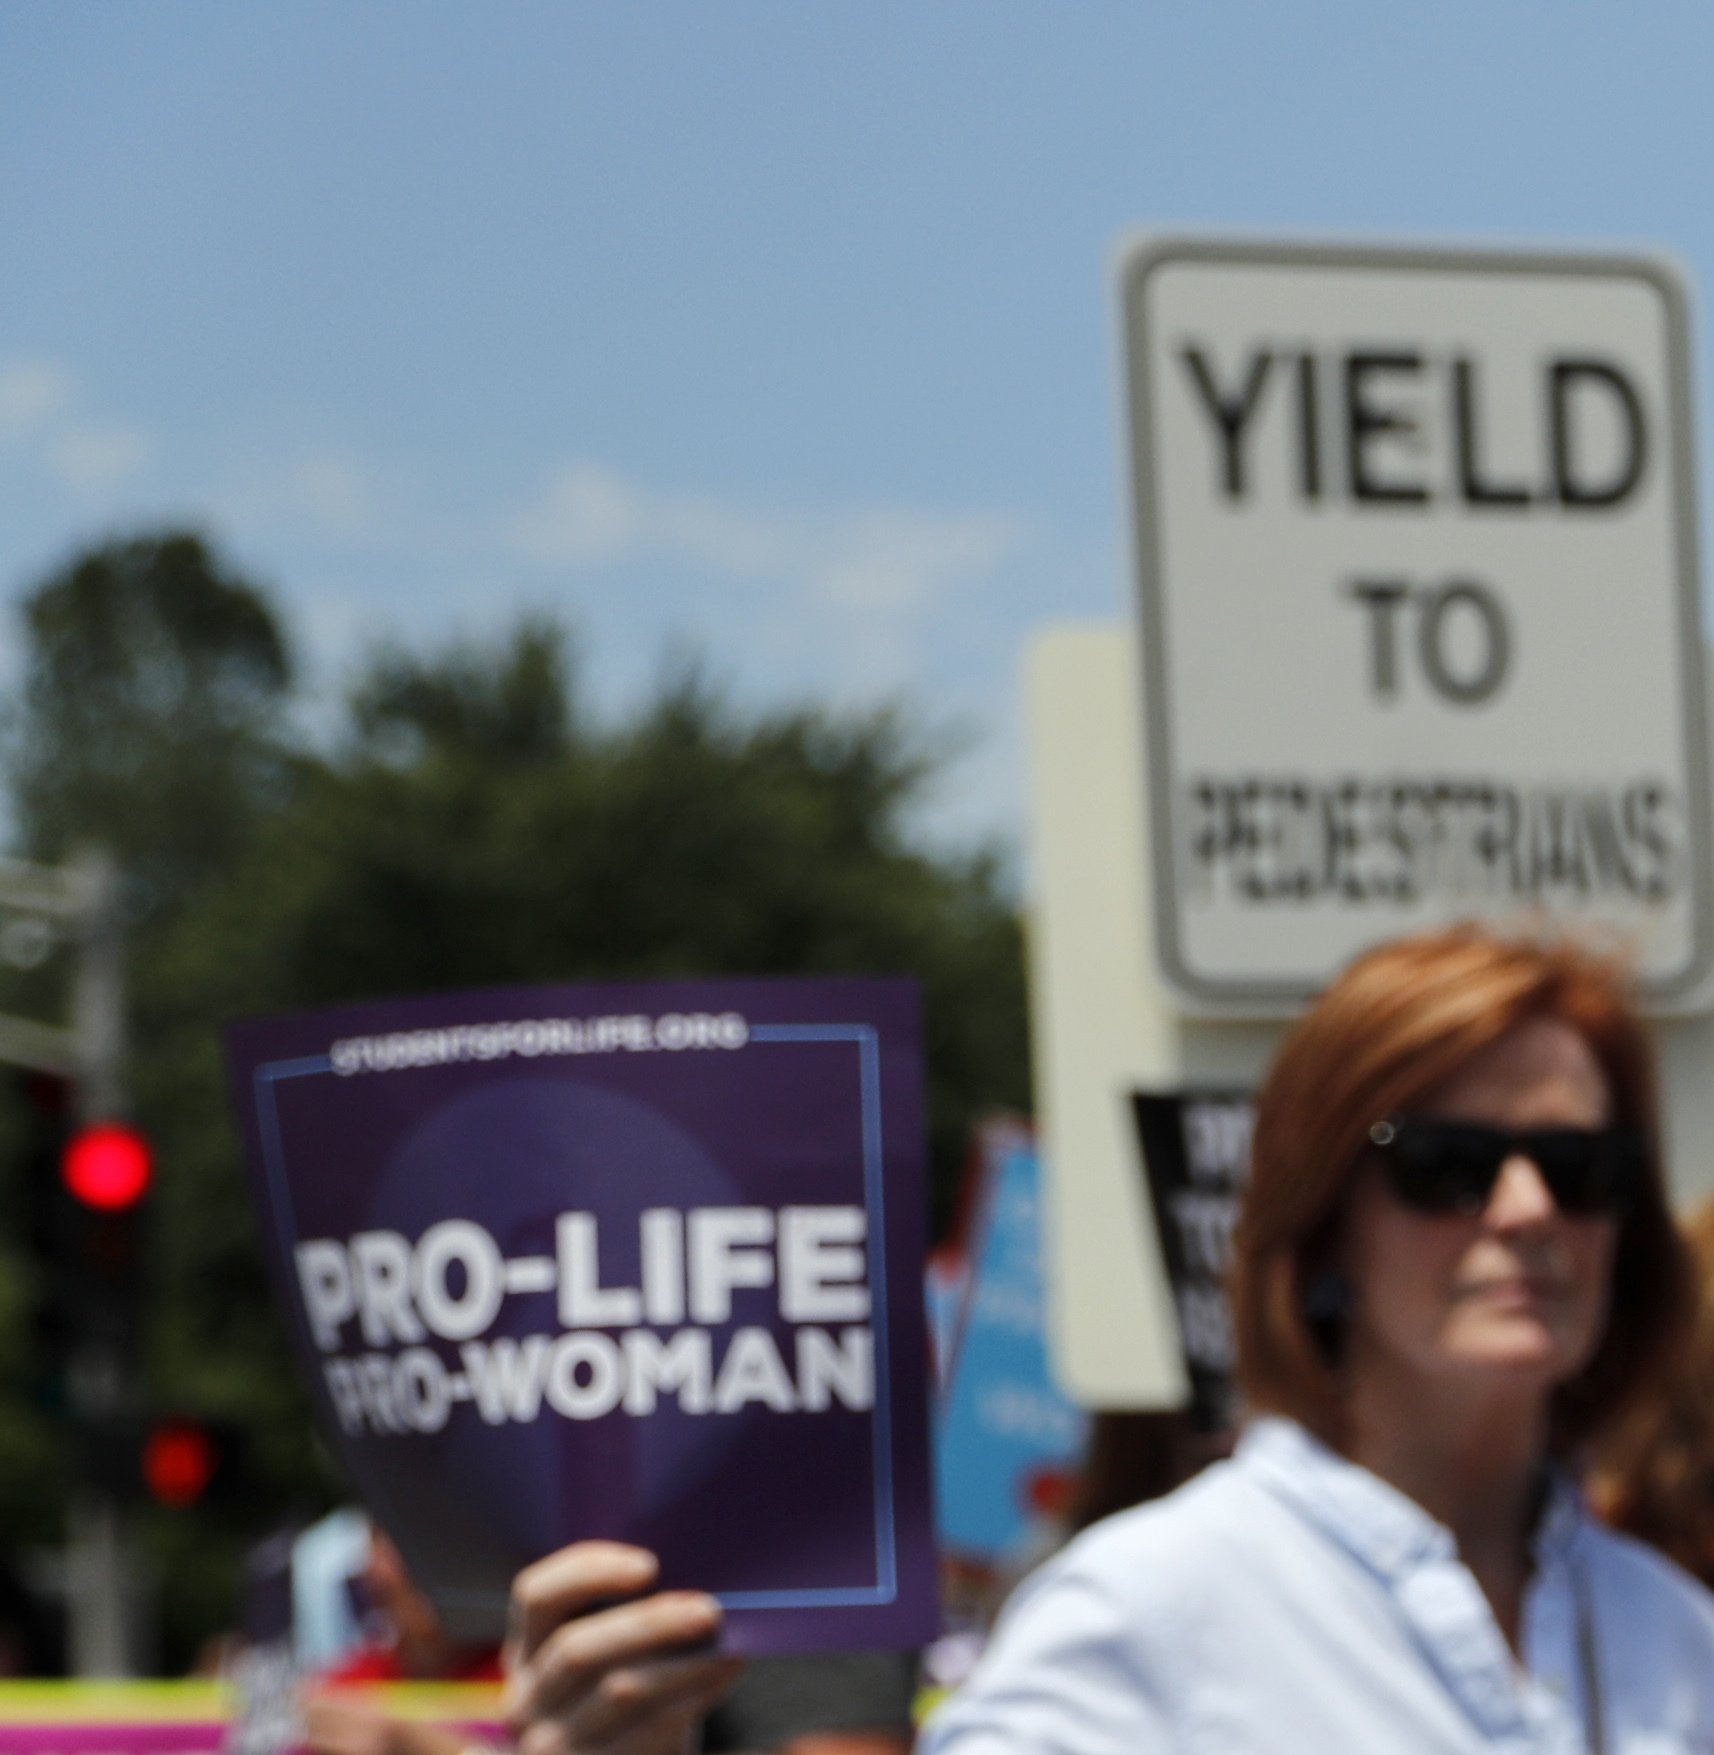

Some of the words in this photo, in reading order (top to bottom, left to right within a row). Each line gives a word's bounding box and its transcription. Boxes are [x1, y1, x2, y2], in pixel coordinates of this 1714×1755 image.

[1178, 340, 1652, 512] YIELD
[1345, 573, 1517, 708] TO
[1188, 775, 1676, 905] PEDESTRIANS
[295, 1204, 873, 1352] PRO-LIFE
[323, 1325, 876, 1437] PRO-WOMAN
